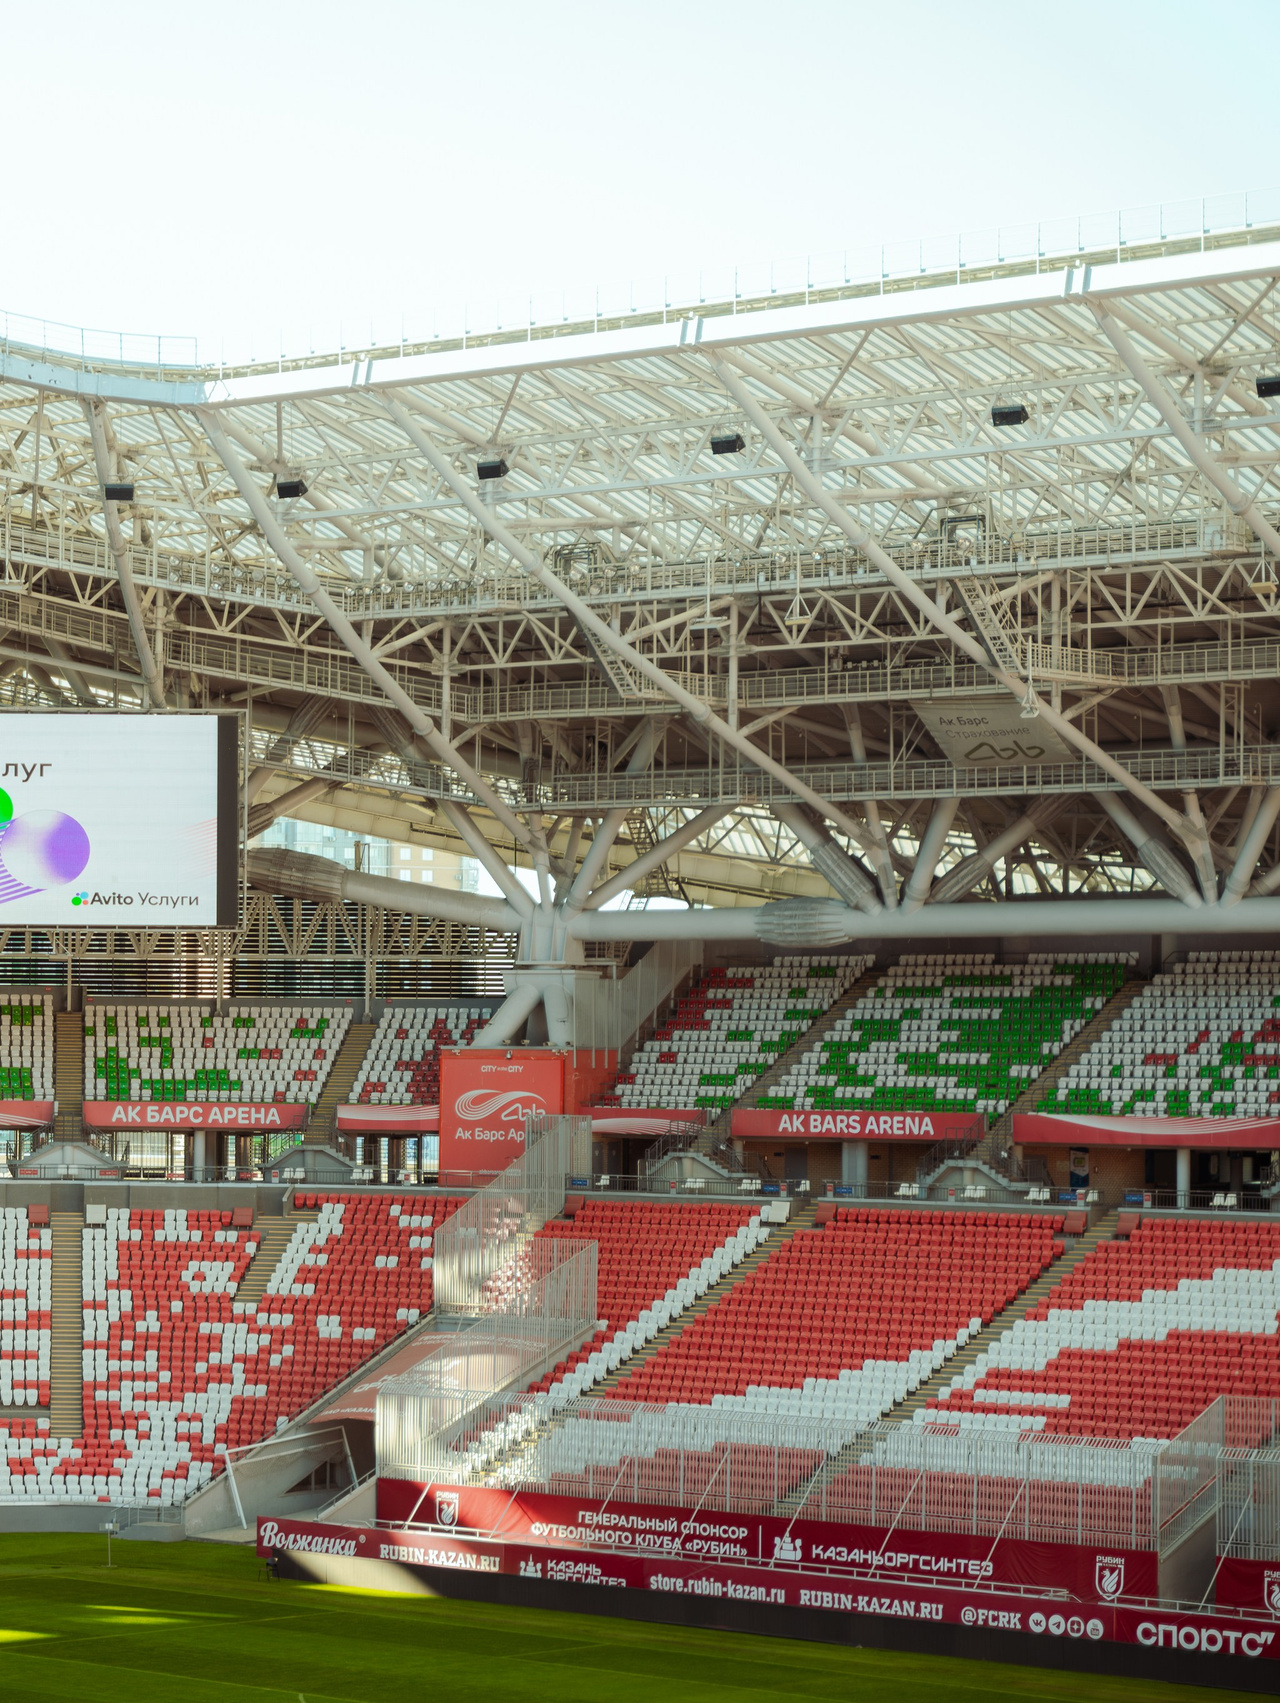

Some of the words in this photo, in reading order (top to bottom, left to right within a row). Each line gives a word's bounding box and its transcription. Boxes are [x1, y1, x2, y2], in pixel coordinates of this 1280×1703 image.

[939, 716, 956, 727] Ак
[957, 715, 989, 727] Барс
[945, 726, 1030, 739] Страхование
[90, 892, 134, 906] Avito
[138, 892, 200, 908] Услуги
[111, 1105, 141, 1123] АК
[146, 1105, 203, 1124] БАРС
[208, 1106, 281, 1125] АРЕНА
[778, 1114, 806, 1133] AK
[809, 1114, 861, 1134] BARS
[865, 1115, 935, 1136] ARENA
[455, 1127, 472, 1140] Ак
[475, 1128, 505, 1143] Барс
[577, 1510, 678, 1533] ГЕНЕРАЛЬНЫЙ
[681, 1521, 748, 1540] СПОНСОР
[259, 1521, 358, 1557] Волжанка
[531, 1521, 633, 1544] ФУТБОЛЬНОГО
[636, 1532, 682, 1550] КЛУБА
[685, 1539, 748, 1557] «РУБИН»
[379, 1543, 500, 1572] RUBIN-KAZAN.RU
[547, 1559, 602, 1576] КАЗАНЬ
[812, 1544, 993, 1576] КАЗАНЬОРГСИНТЕЗ
[1096, 1555, 1125, 1565] РУБИН
[1264, 1570, 1280, 1578] РУБ
[650, 1573, 785, 1604] store.rubin-kazan.ru
[800, 1589, 944, 1620] RUBIN-KAZAN.RU
[960, 1606, 1022, 1629] @FCRK
